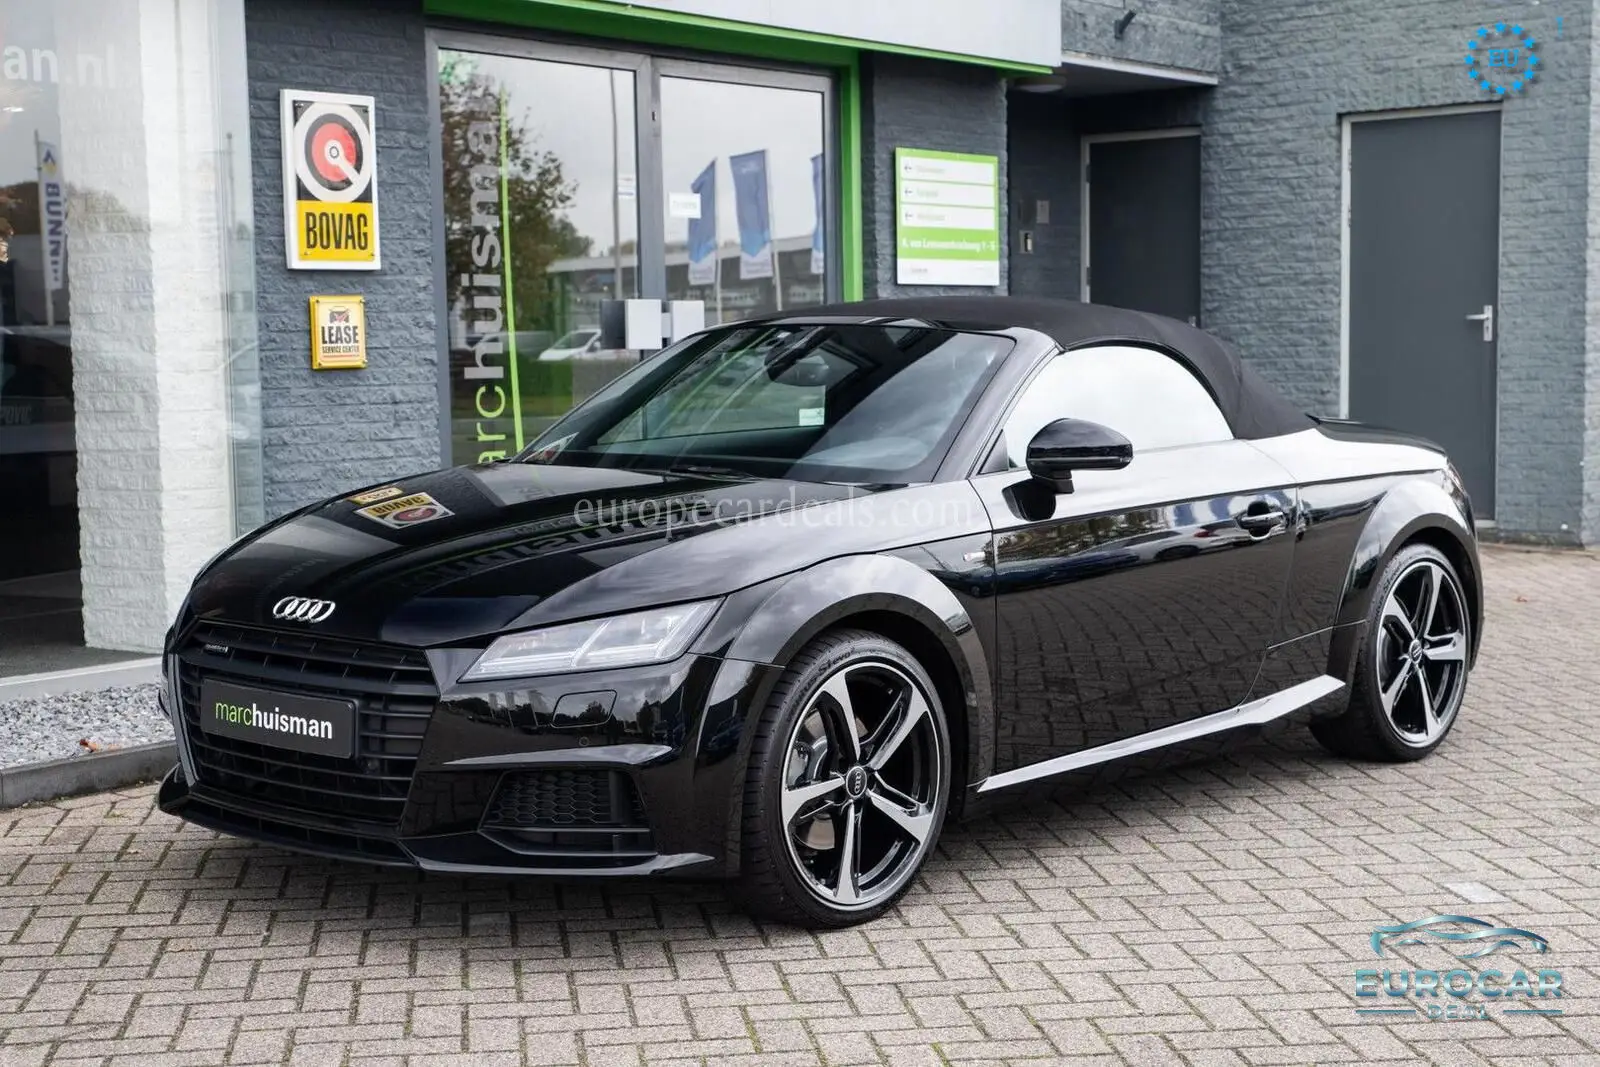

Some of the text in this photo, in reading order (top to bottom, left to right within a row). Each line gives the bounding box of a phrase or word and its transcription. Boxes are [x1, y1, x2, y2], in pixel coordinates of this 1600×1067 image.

[305, 211, 369, 251] BOVAG
[321, 326, 359, 345] LEASE
[215, 700, 333, 739] marchuisman
